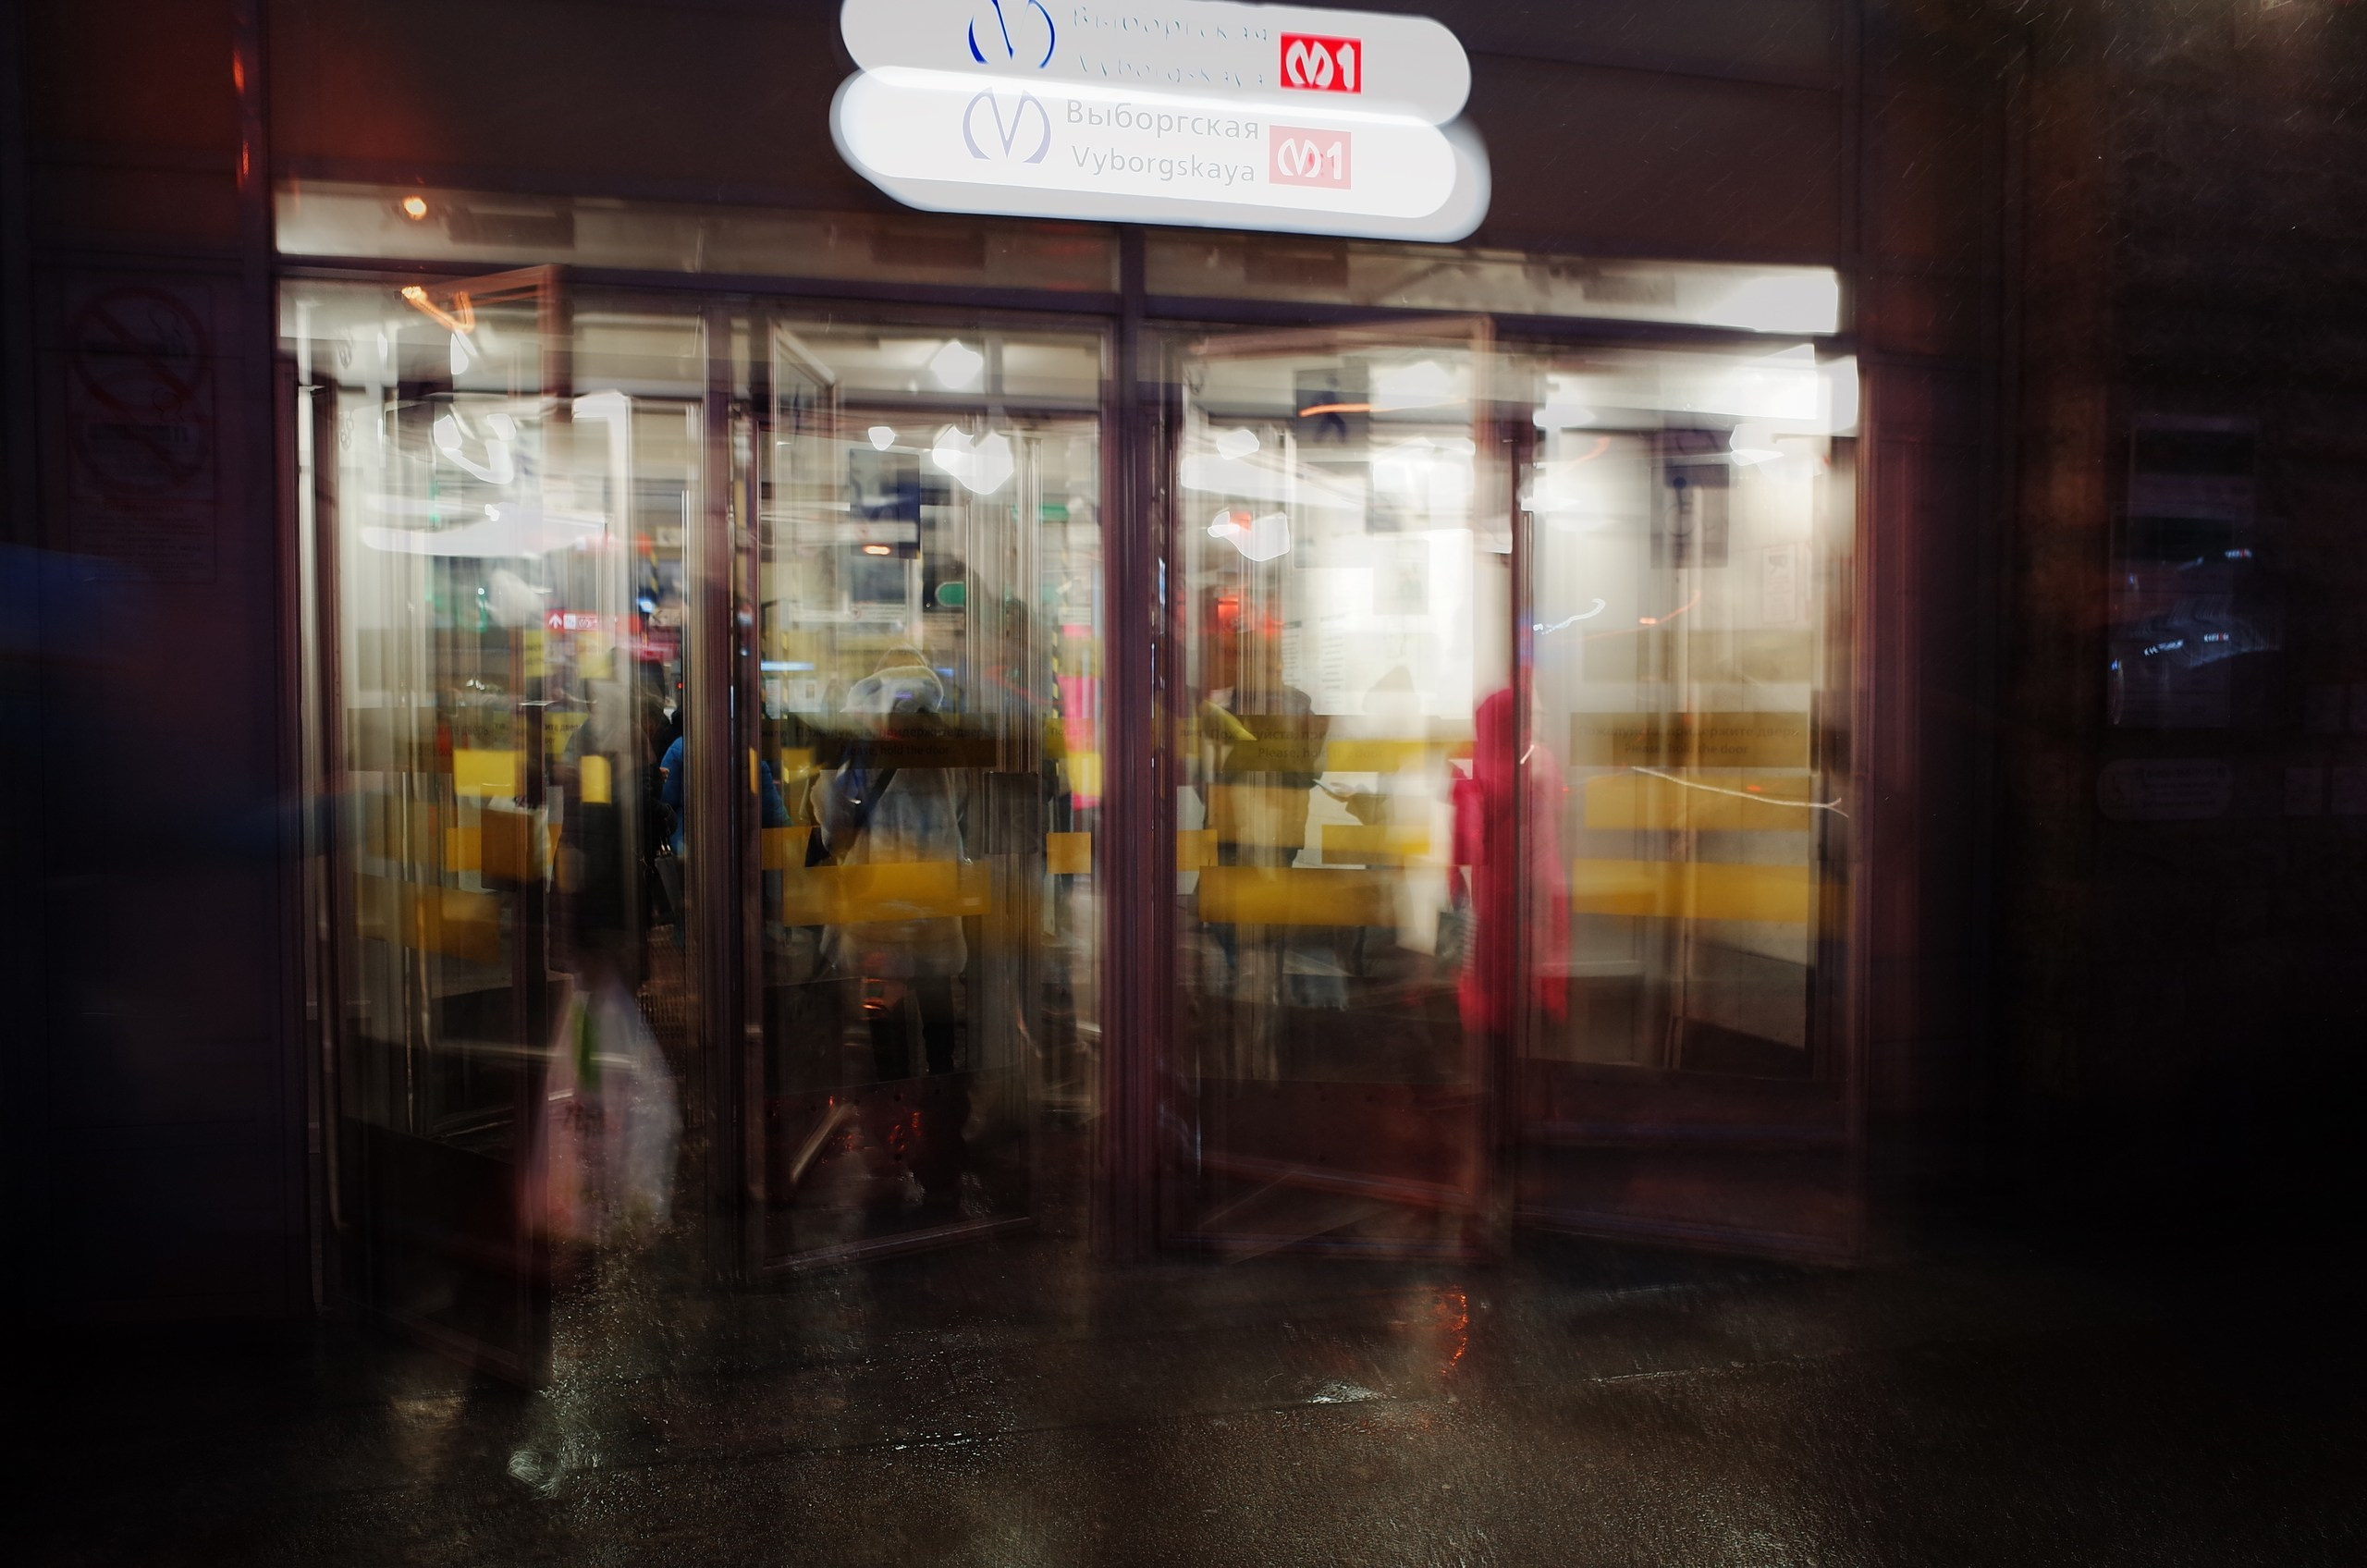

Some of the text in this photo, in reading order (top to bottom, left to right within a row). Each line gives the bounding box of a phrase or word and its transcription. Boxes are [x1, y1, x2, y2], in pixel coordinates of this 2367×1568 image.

[1066, 98, 1259, 141] Выборгская
[1072, 145, 1255, 187] Vyborgskaya
[1210, 728, 1298, 741] Пожуйста,
[1667, 727, 1754, 739] приержите
